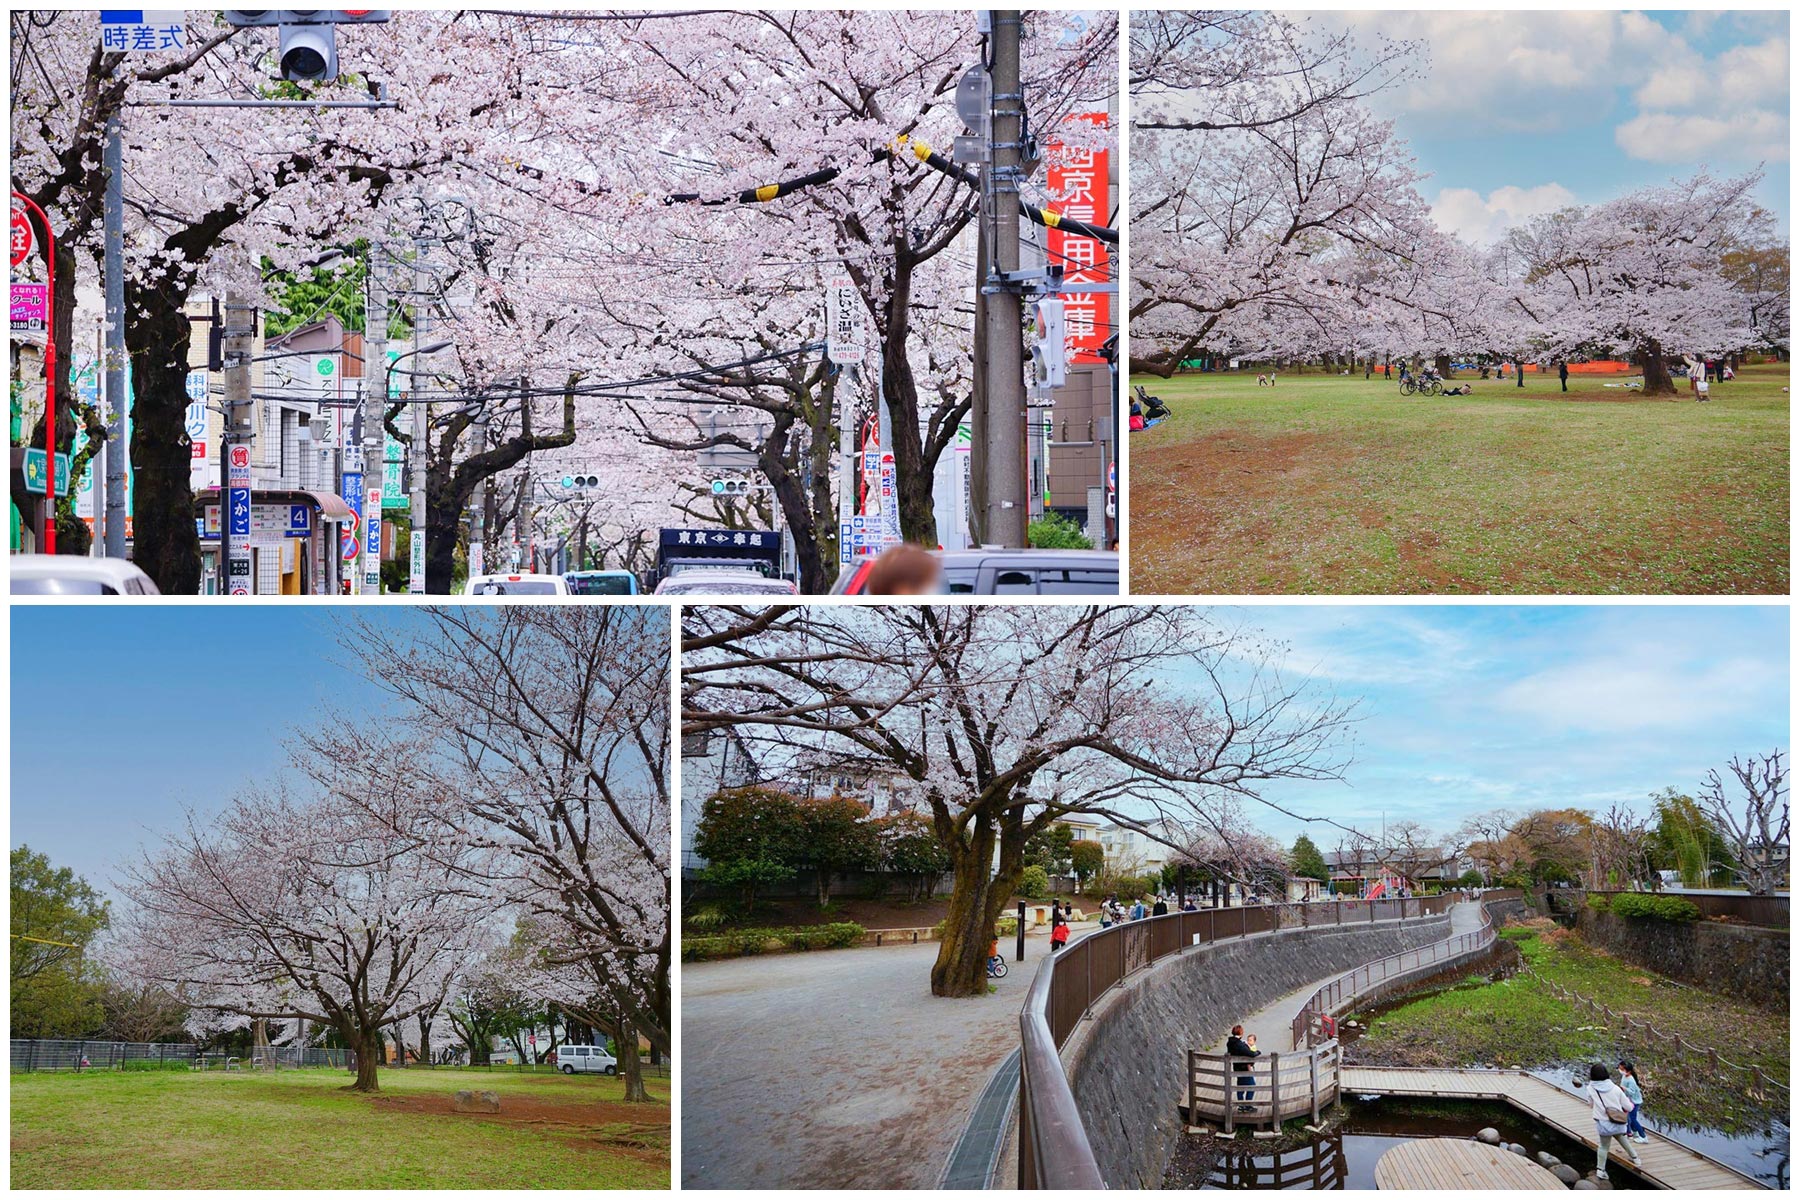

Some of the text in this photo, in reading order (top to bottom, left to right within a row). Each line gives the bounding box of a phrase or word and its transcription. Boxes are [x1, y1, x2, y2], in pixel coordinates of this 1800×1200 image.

[104, 25, 184, 50] 時差式
[234, 489, 248, 532] つかご
[293, 509, 304, 524] 4
[369, 520, 379, 552] つかご
[678, 530, 707, 544] 東京
